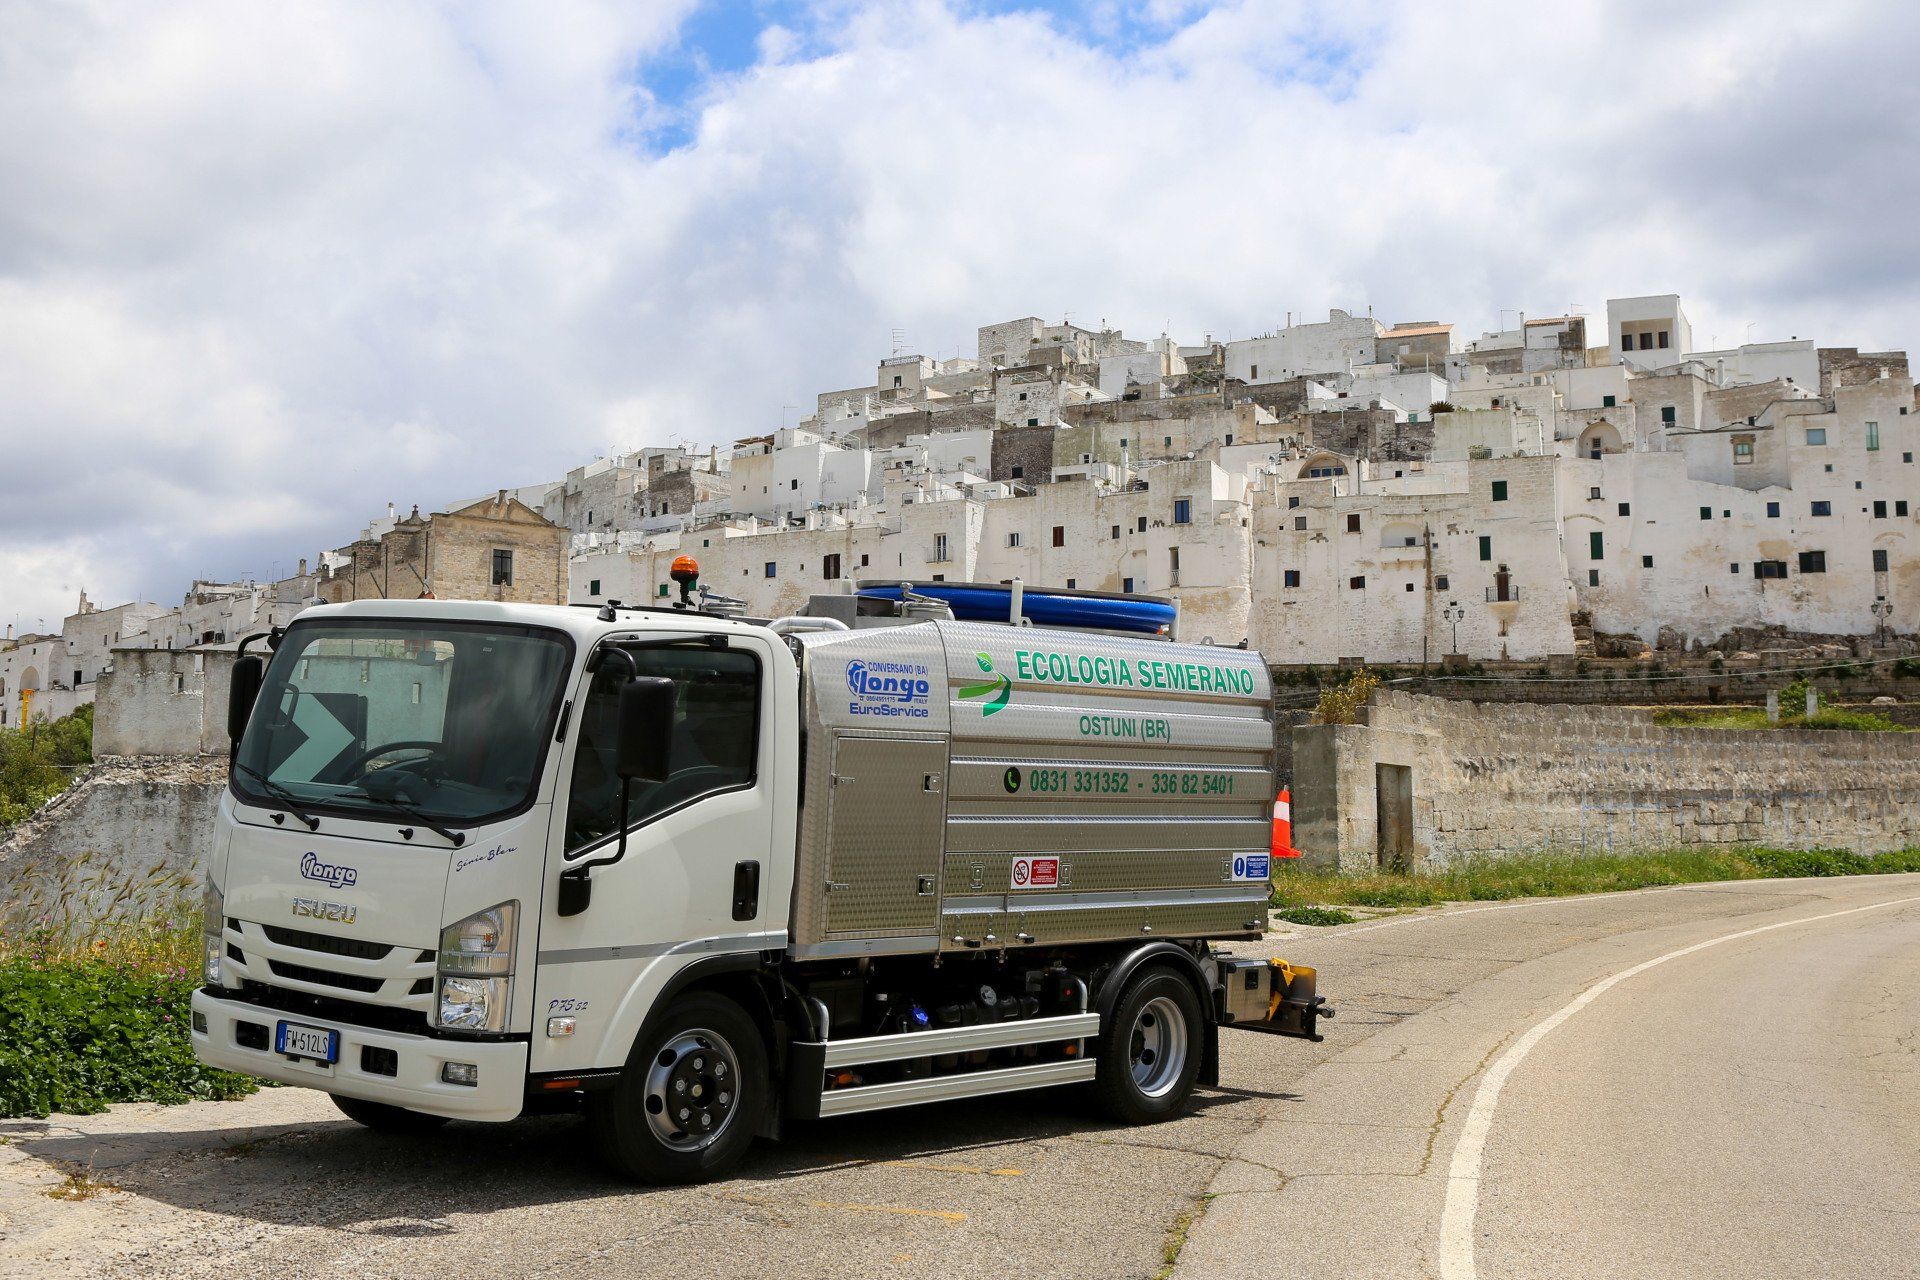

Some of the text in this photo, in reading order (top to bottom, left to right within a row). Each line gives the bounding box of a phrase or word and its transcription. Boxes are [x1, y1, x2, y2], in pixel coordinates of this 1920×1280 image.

[868, 662, 929, 677] CONVERSANO (BA)
[1014, 650, 1254, 695] ECOLOGIA SEMERANO
[850, 702, 929, 717] EuroService
[1080, 715, 1171, 744] OSTUNI (BR)
[1030, 769, 1068, 792] 0831
[1073, 770, 1129, 793] 331352
[1152, 773, 1177, 794] 336
[1181, 773, 1198, 794] 82
[1202, 774, 1233, 795] 5401
[293, 896, 357, 925] ISUZU
